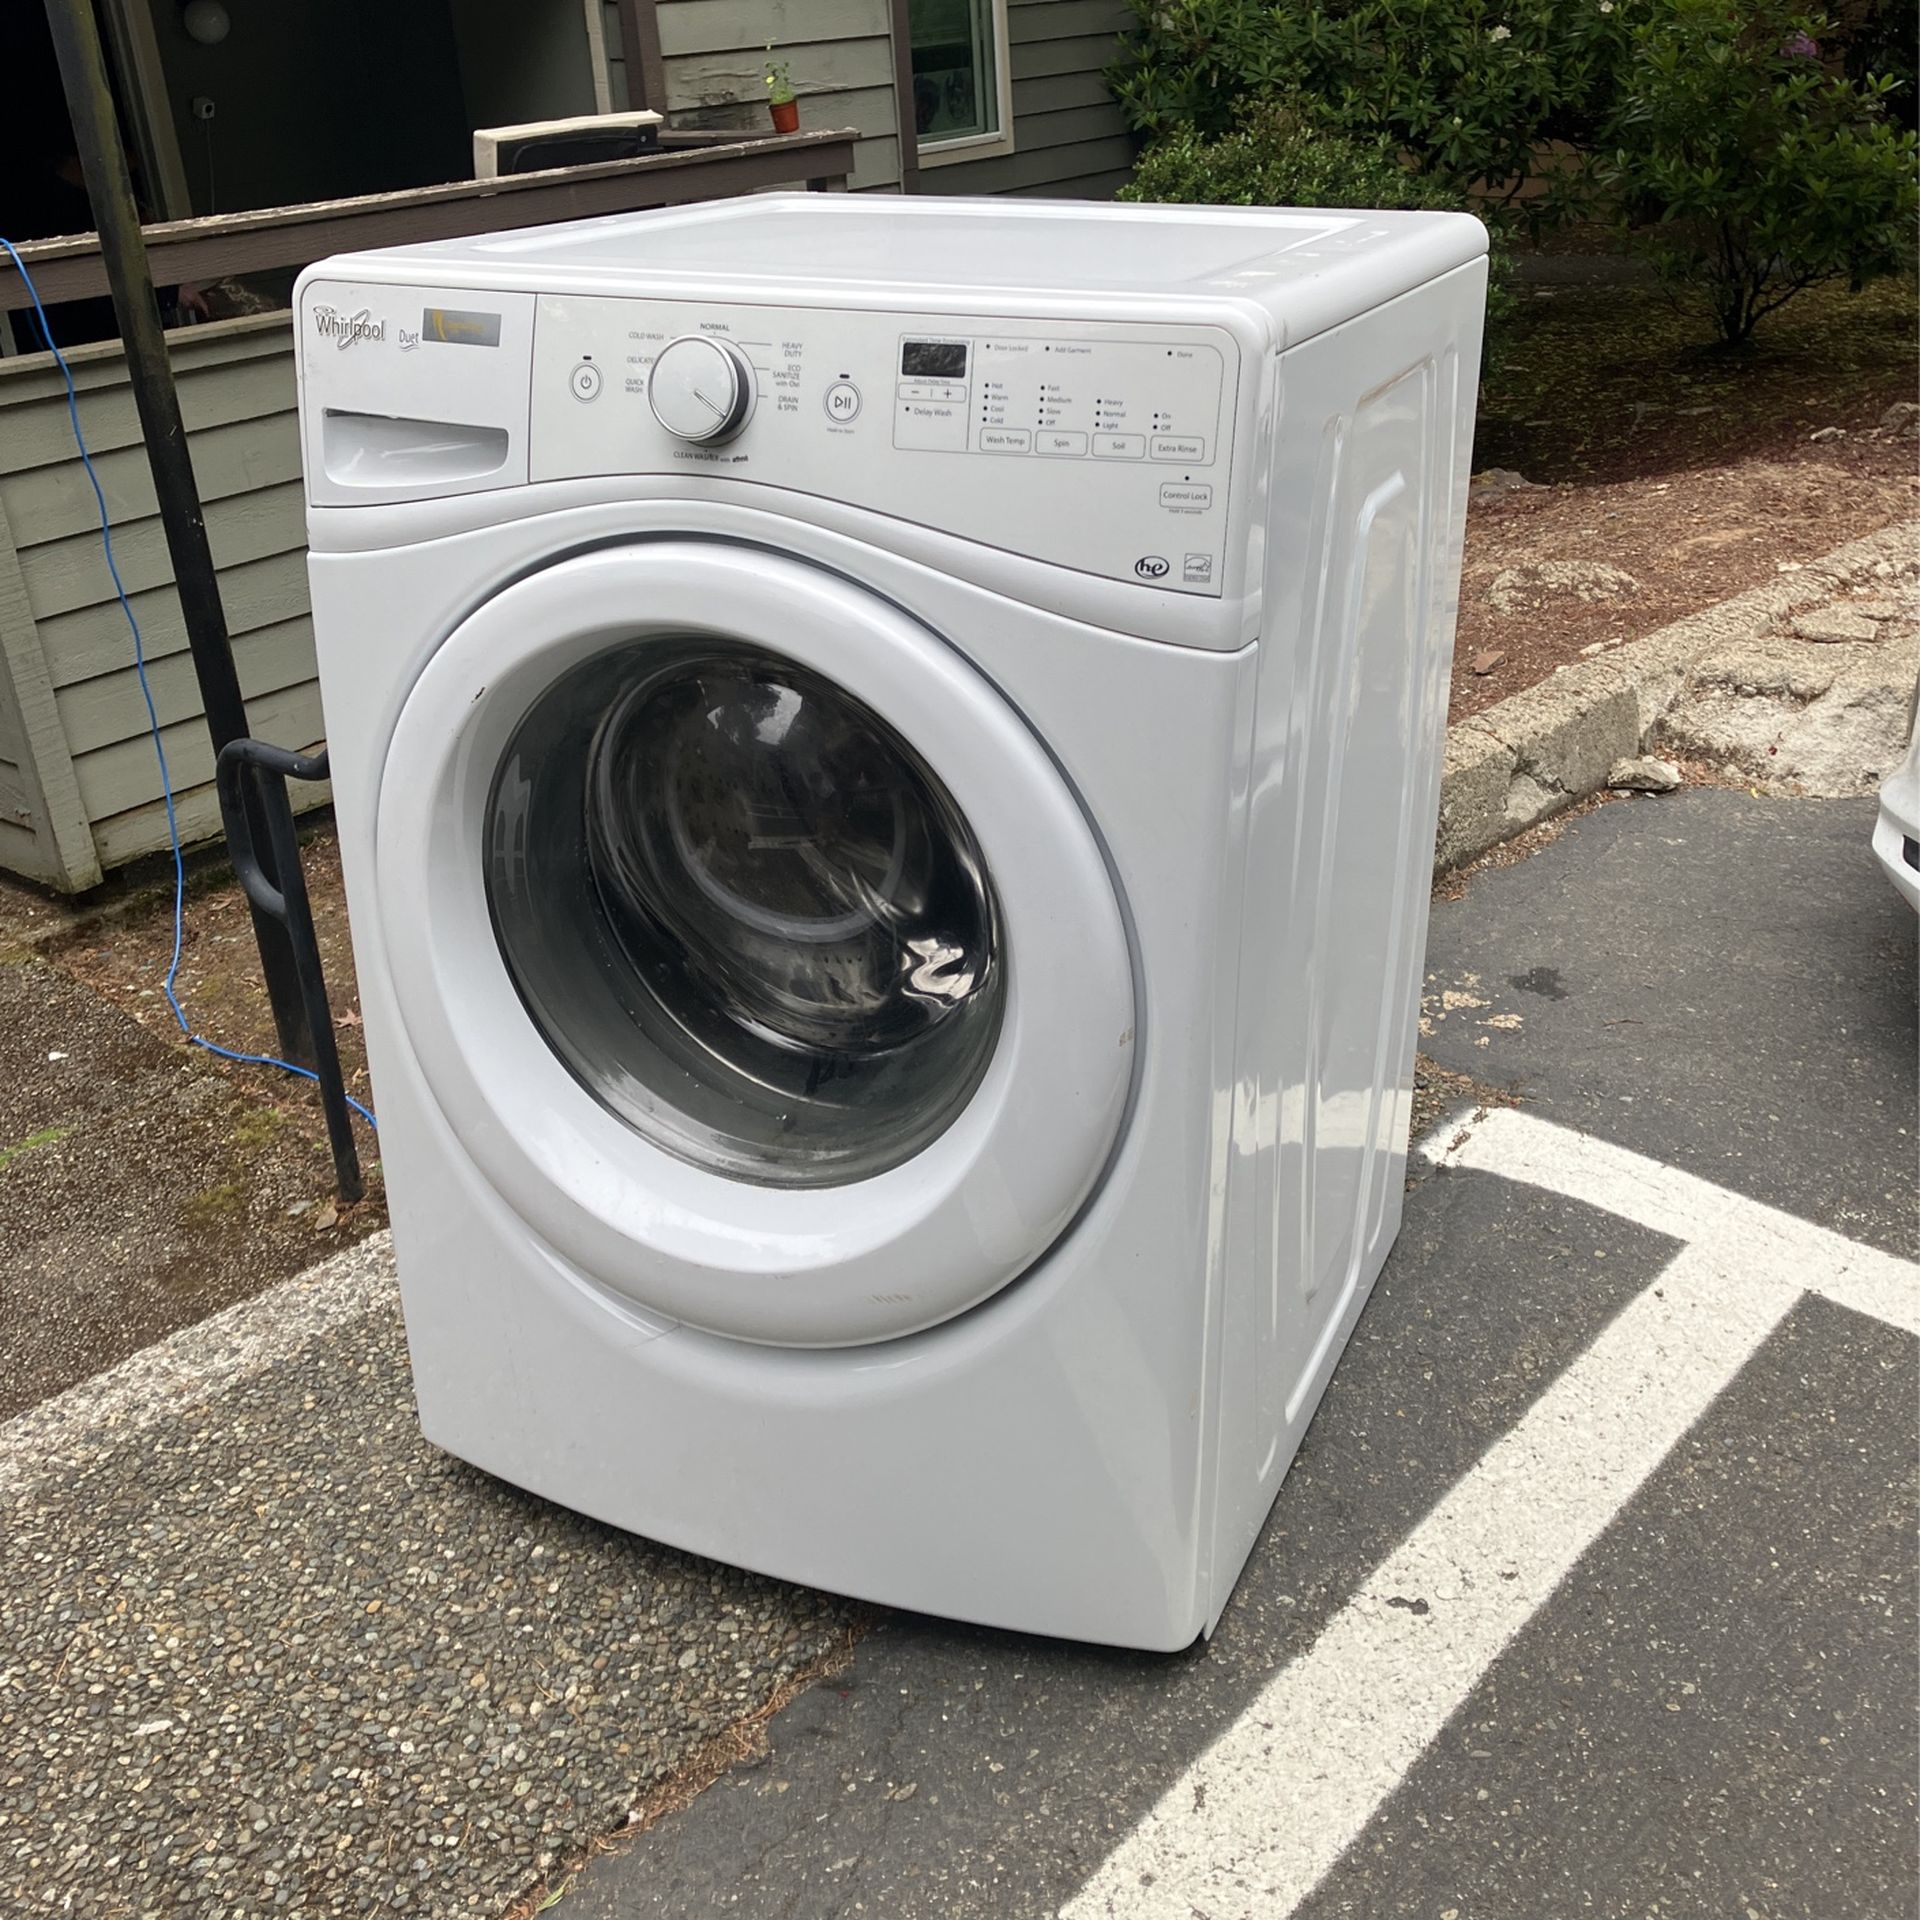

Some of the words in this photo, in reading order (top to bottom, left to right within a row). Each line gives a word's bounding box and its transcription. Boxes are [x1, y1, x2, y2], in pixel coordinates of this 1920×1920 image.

[315, 312, 386, 345] Whirlpool
[700, 323, 729, 331] NORMAL
[399, 328, 419, 343] Duet
[628, 331, 645, 340] COLD
[782, 342, 803, 350] HEAVY
[784, 350, 802, 358] DUTY
[1176, 350, 1193, 358] Done
[787, 364, 801, 372] ECO
[772, 371, 800, 380] SANITIZE
[625, 378, 644, 386] QUICK
[1047, 384, 1061, 392] Fast
[778, 395, 798, 404] DRAIN
[1047, 396, 1072, 404] Medium
[1104, 398, 1124, 406] Heavy
[914, 407, 933, 418] Delay
[934, 409, 952, 417] Wash
[1103, 410, 1126, 418] Normal
[1161, 412, 1171, 420] On
[1102, 421, 1119, 430] Light
[1160, 423, 1172, 431] Off
[986, 434, 1005, 444] Wash
[1006, 435, 1026, 447] Temp
[1053, 437, 1071, 448] Spin
[1112, 441, 1126, 450] Soil
[1158, 443, 1177, 453] Extra
[1177, 445, 1198, 454] Rinse
[673, 450, 693, 460] CLEAN
[1163, 490, 1190, 499] Control
[1190, 492, 1208, 501] Lock
